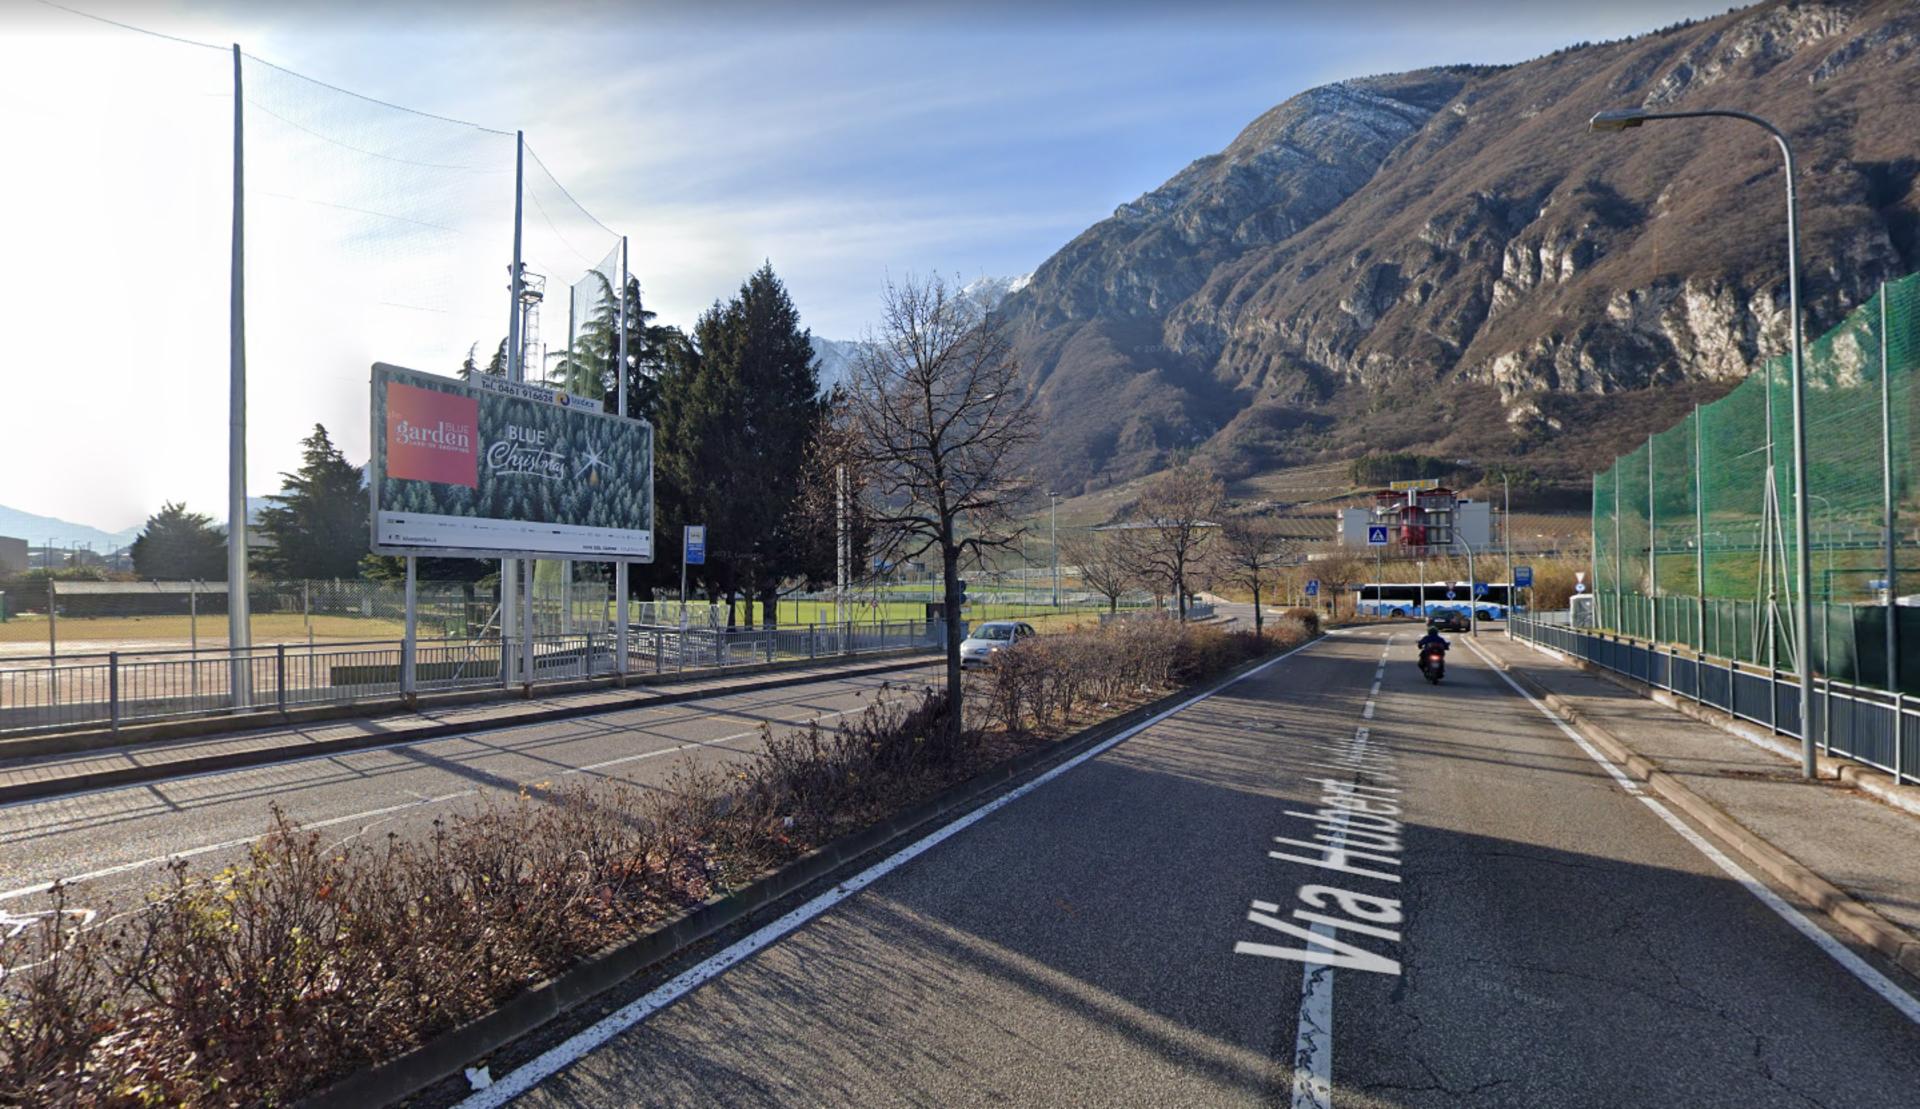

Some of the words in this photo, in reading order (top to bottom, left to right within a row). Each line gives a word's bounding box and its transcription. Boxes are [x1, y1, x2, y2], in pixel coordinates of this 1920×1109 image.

[498, 385, 519, 396] 0461
[523, 388, 554, 403] 916624
[395, 420, 470, 448] garden
[445, 422, 470, 434] BLUE
[508, 424, 545, 445] BLUE
[487, 441, 565, 480] Christmas
